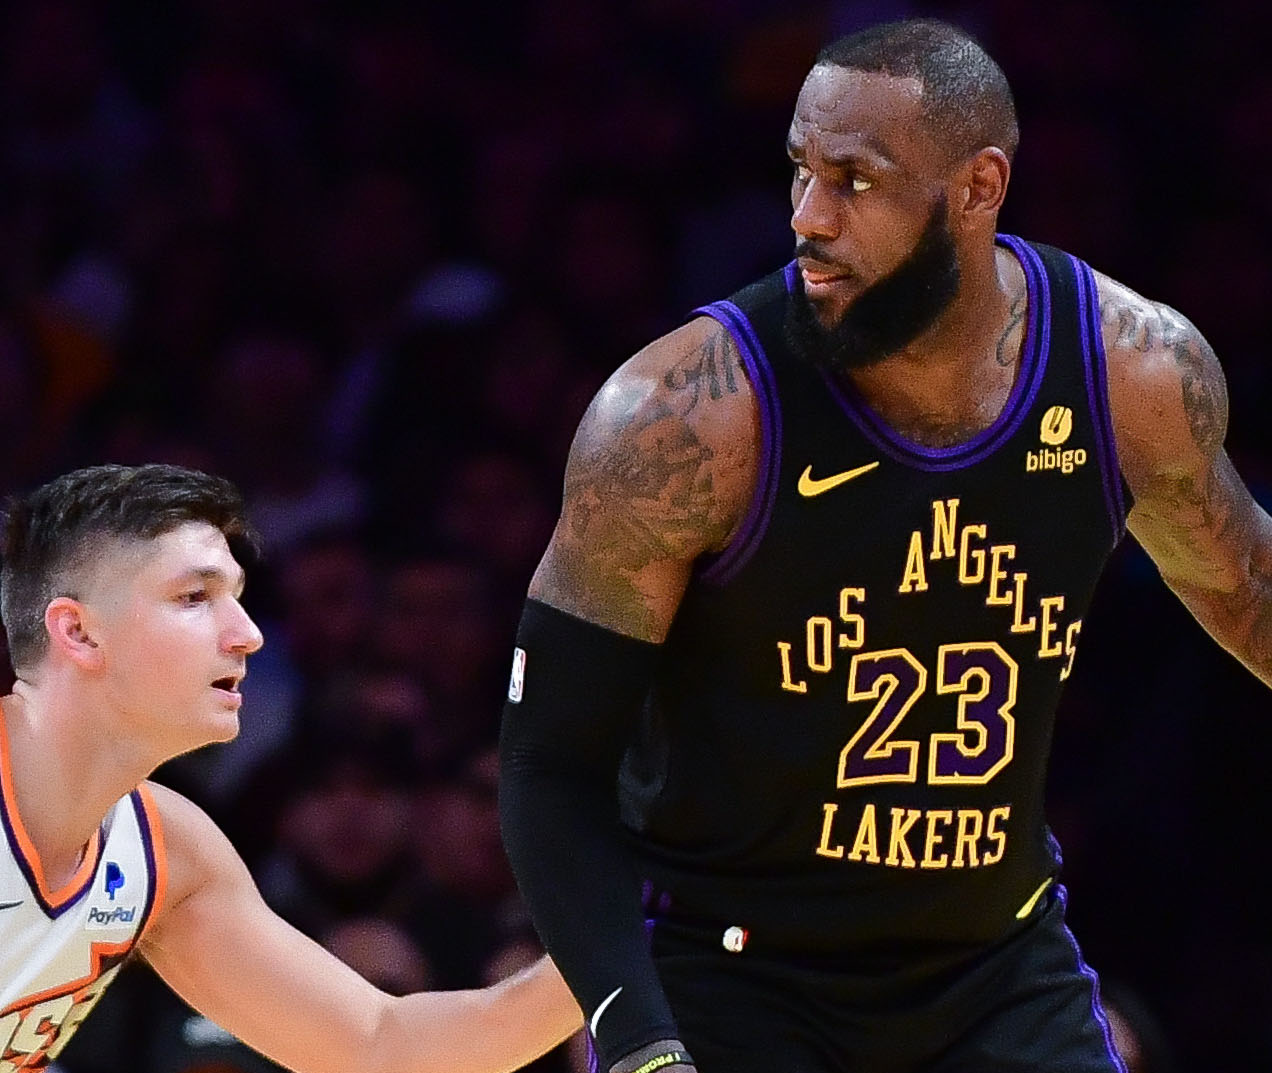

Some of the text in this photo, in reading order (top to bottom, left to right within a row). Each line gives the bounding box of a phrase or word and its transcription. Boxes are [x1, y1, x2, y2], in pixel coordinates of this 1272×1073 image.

[1026, 448, 1087, 474] bibigo
[777, 498, 1082, 693] LOS ANGELES
[836, 641, 1019, 789] 23
[816, 803, 1011, 869] LAKERS
[88, 906, 136, 925] PayPal
